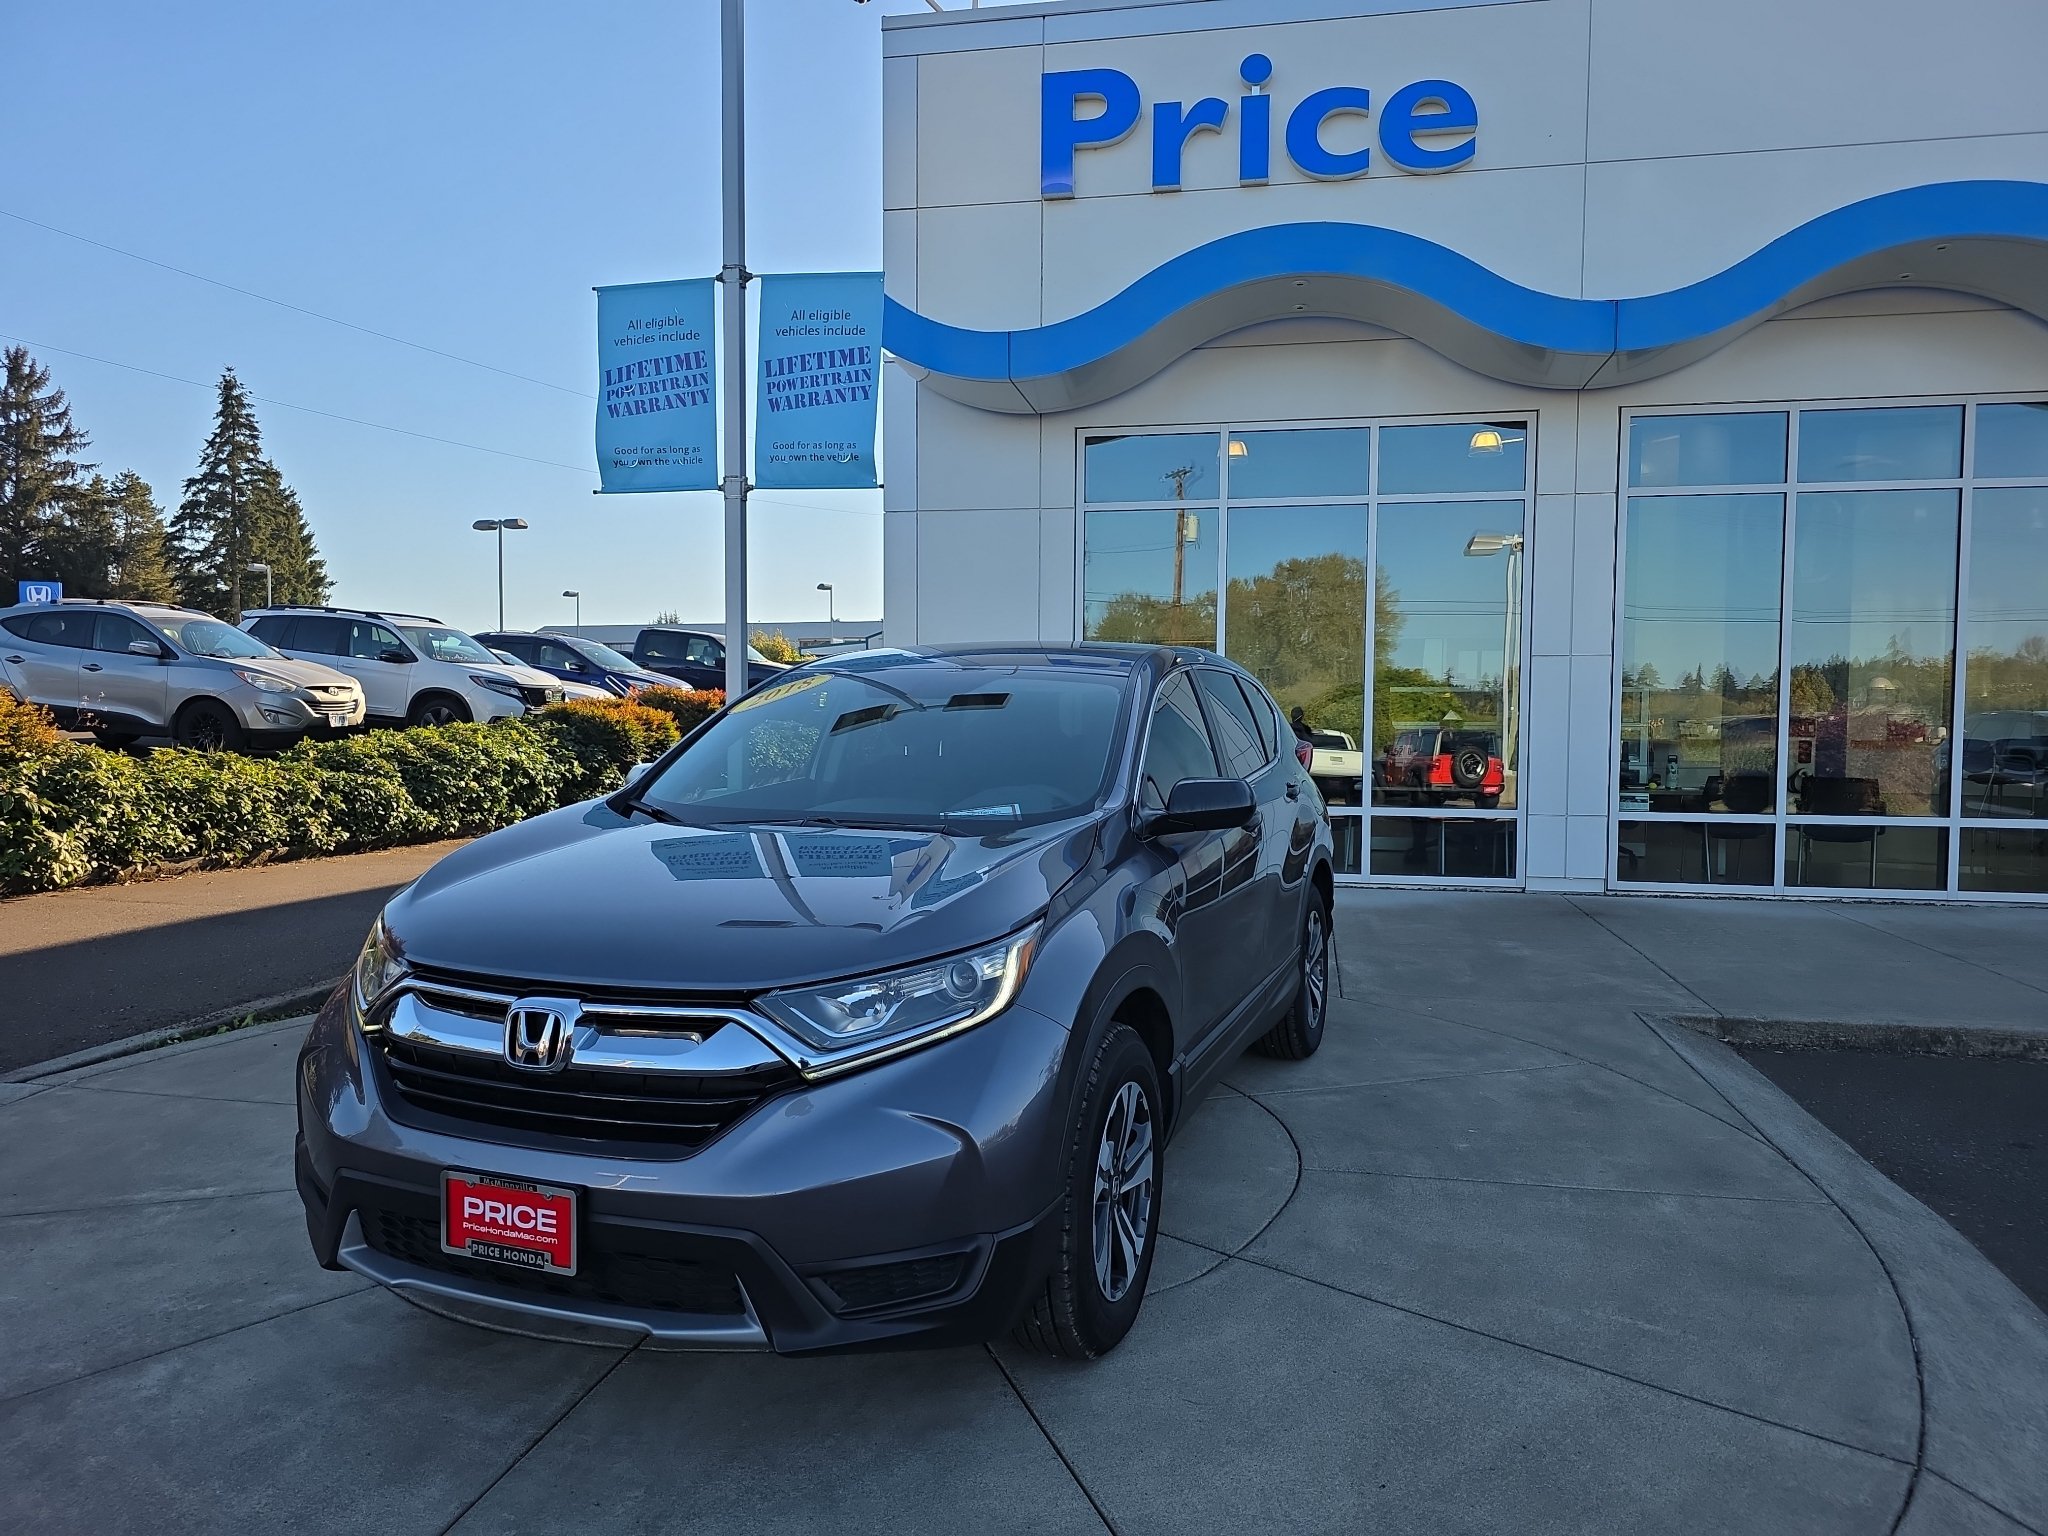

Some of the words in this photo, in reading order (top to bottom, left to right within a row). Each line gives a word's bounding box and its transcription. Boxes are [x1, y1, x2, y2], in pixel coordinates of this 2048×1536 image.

[1041, 53, 1478, 200] Price
[628, 319, 642, 330] All
[645, 315, 685, 330] eligible
[791, 310, 805, 321] All
[808, 309, 851, 323] eligible
[614, 333, 656, 346] vehicles
[658, 329, 700, 342] include
[775, 325, 820, 336] vehicles
[823, 325, 866, 336] include
[605, 350, 708, 387] LIFETIME
[764, 346, 871, 378] LIFETIME
[606, 372, 709, 402] POWERTRAIN
[766, 368, 872, 395] POWERTRAIN
[606, 388, 711, 419] WARRANTY
[767, 385, 873, 413] WARRANTY
[614, 446, 638, 455] Good
[640, 446, 655, 454] for
[669, 445, 690, 455] long
[772, 441, 795, 450] Good
[797, 441, 810, 450] for
[824, 441, 845, 452] long
[613, 459, 629, 469] you
[654, 457, 670, 466] the
[769, 454, 786, 464] you
[788, 454, 808, 462] own
[809, 453, 825, 462] the
[826, 453, 861, 463] vehicle
[483, 1177, 534, 1192] McMinnville
[463, 1196, 557, 1233] PRICE
[462, 1221, 558, 1245] PriceHondaMac.com
[472, 1243, 500, 1258] PRICE
[503, 1249, 544, 1265] HONDA
